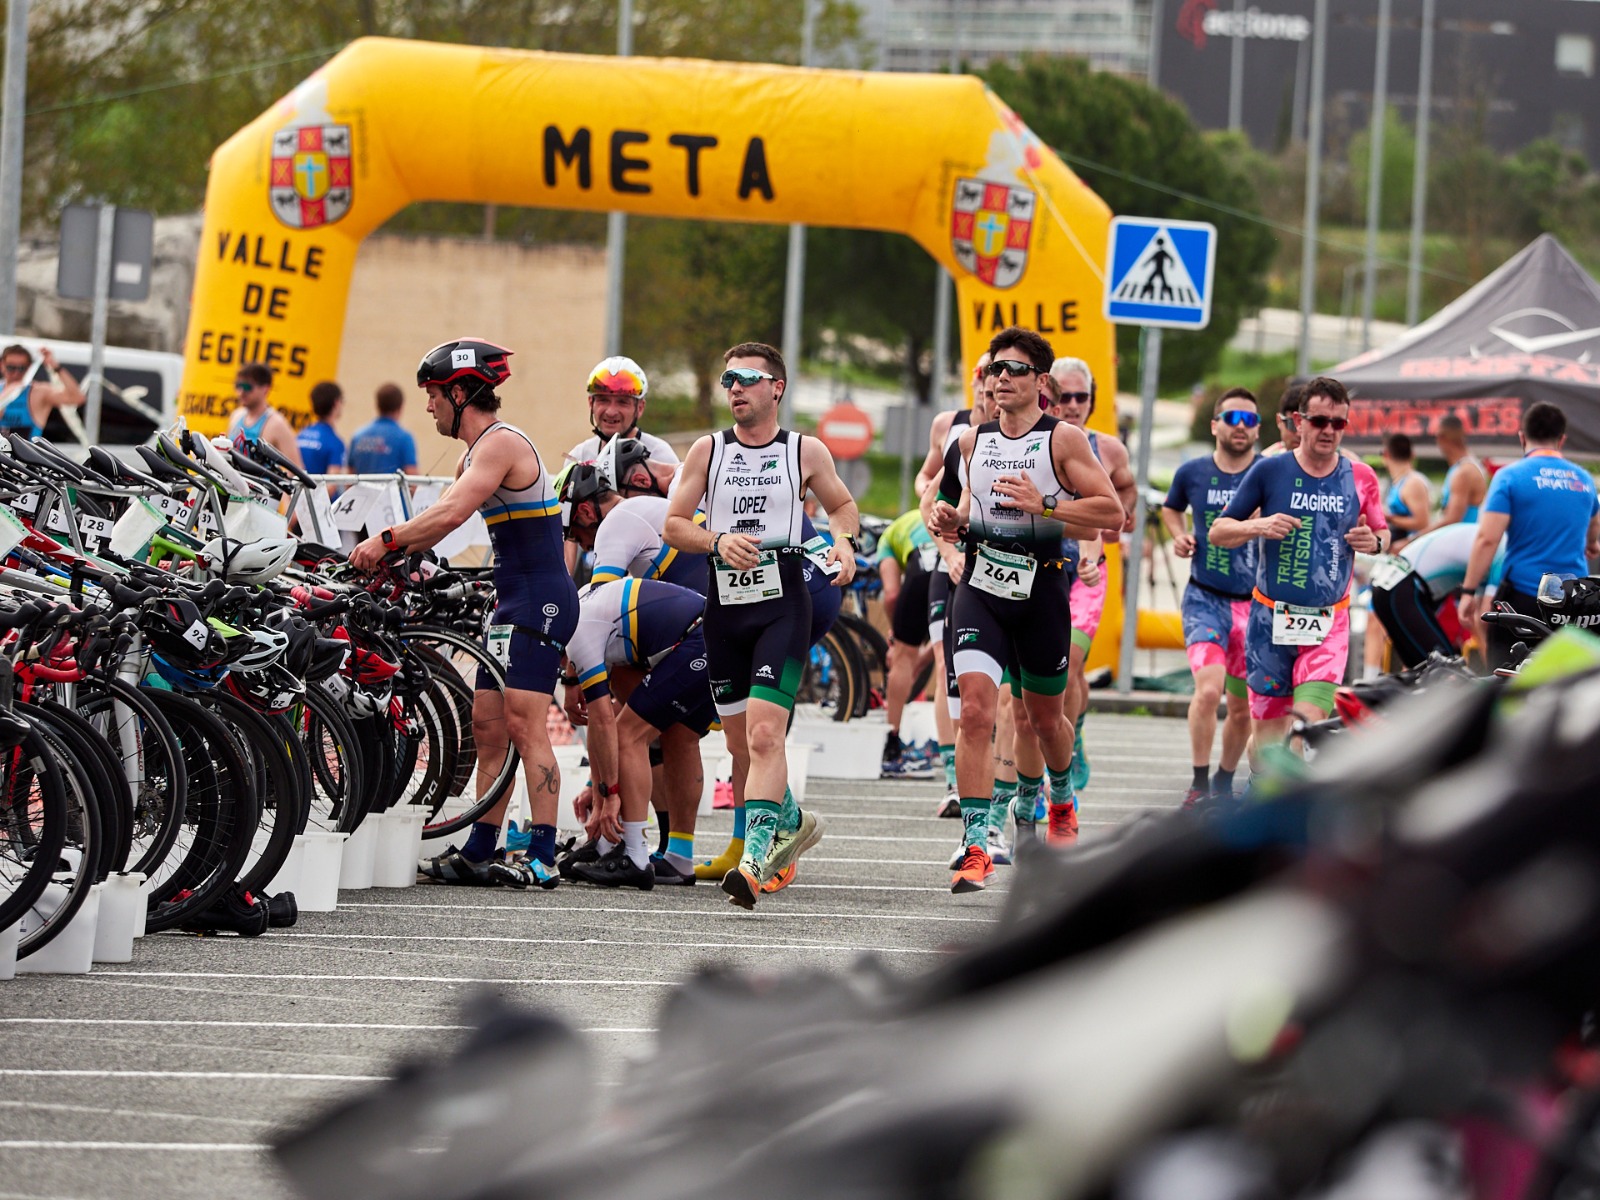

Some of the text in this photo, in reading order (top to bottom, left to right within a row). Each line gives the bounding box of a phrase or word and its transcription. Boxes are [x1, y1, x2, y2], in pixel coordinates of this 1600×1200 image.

[543, 123, 775, 201] META
[218, 230, 325, 281] VALLE
[242, 283, 290, 321] DE
[973, 300, 1080, 335] VALLE
[456, 353, 469, 362] 30
[732, 495, 768, 514] LOPEZ
[1207, 488, 1235, 505] MART
[1290, 492, 1345, 513] IZAGIRRE
[87, 518, 105, 532] 28
[1291, 515, 1314, 589] ANTSOAIN
[727, 569, 765, 588] 26E
[984, 562, 1020, 586] 26A
[1285, 616, 1322, 633] 29A
[192, 628, 206, 643] 26
